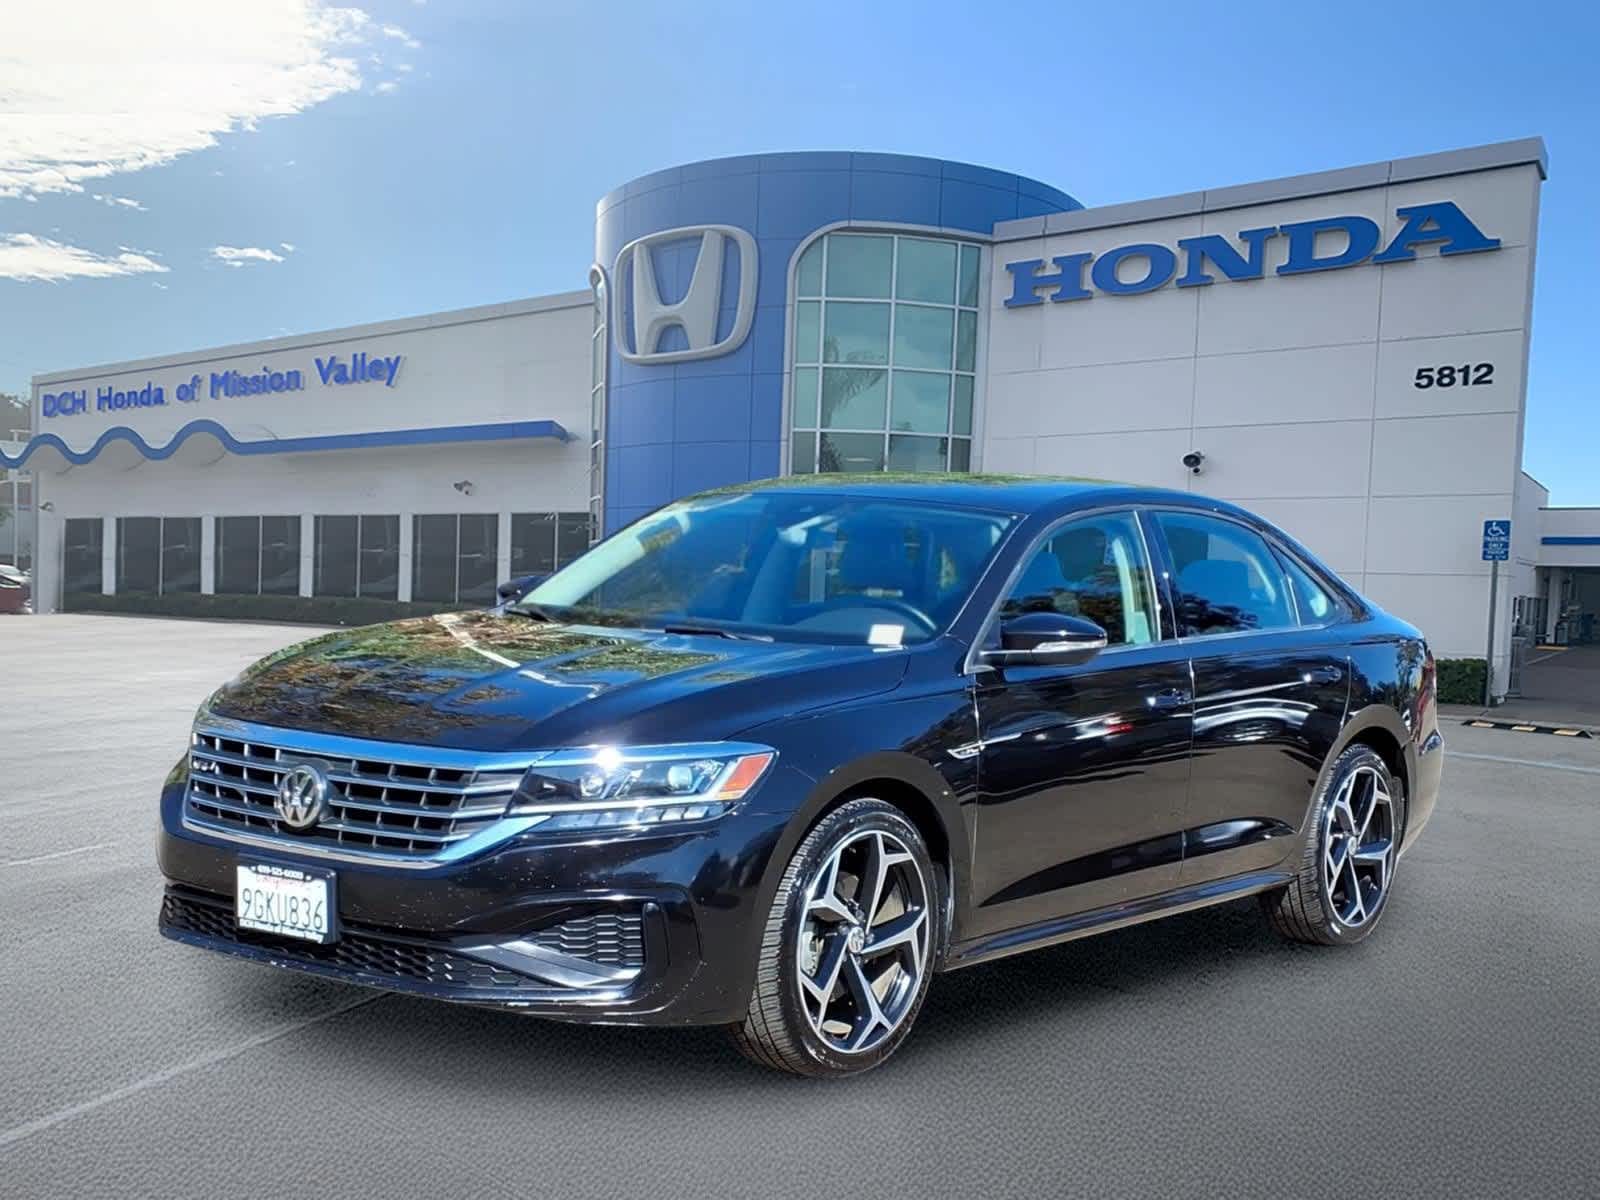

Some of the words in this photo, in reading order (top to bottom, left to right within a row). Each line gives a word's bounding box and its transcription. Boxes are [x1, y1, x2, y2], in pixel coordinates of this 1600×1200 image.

[1003, 201, 1502, 308] HONDA
[42, 390, 88, 417] DCH
[97, 380, 166, 411] Honda
[176, 374, 202, 402] of
[210, 366, 303, 399] Mission
[315, 352, 403, 387] Valley
[1414, 363, 1494, 389] 5812
[242, 888, 324, 930] 9GKU836
